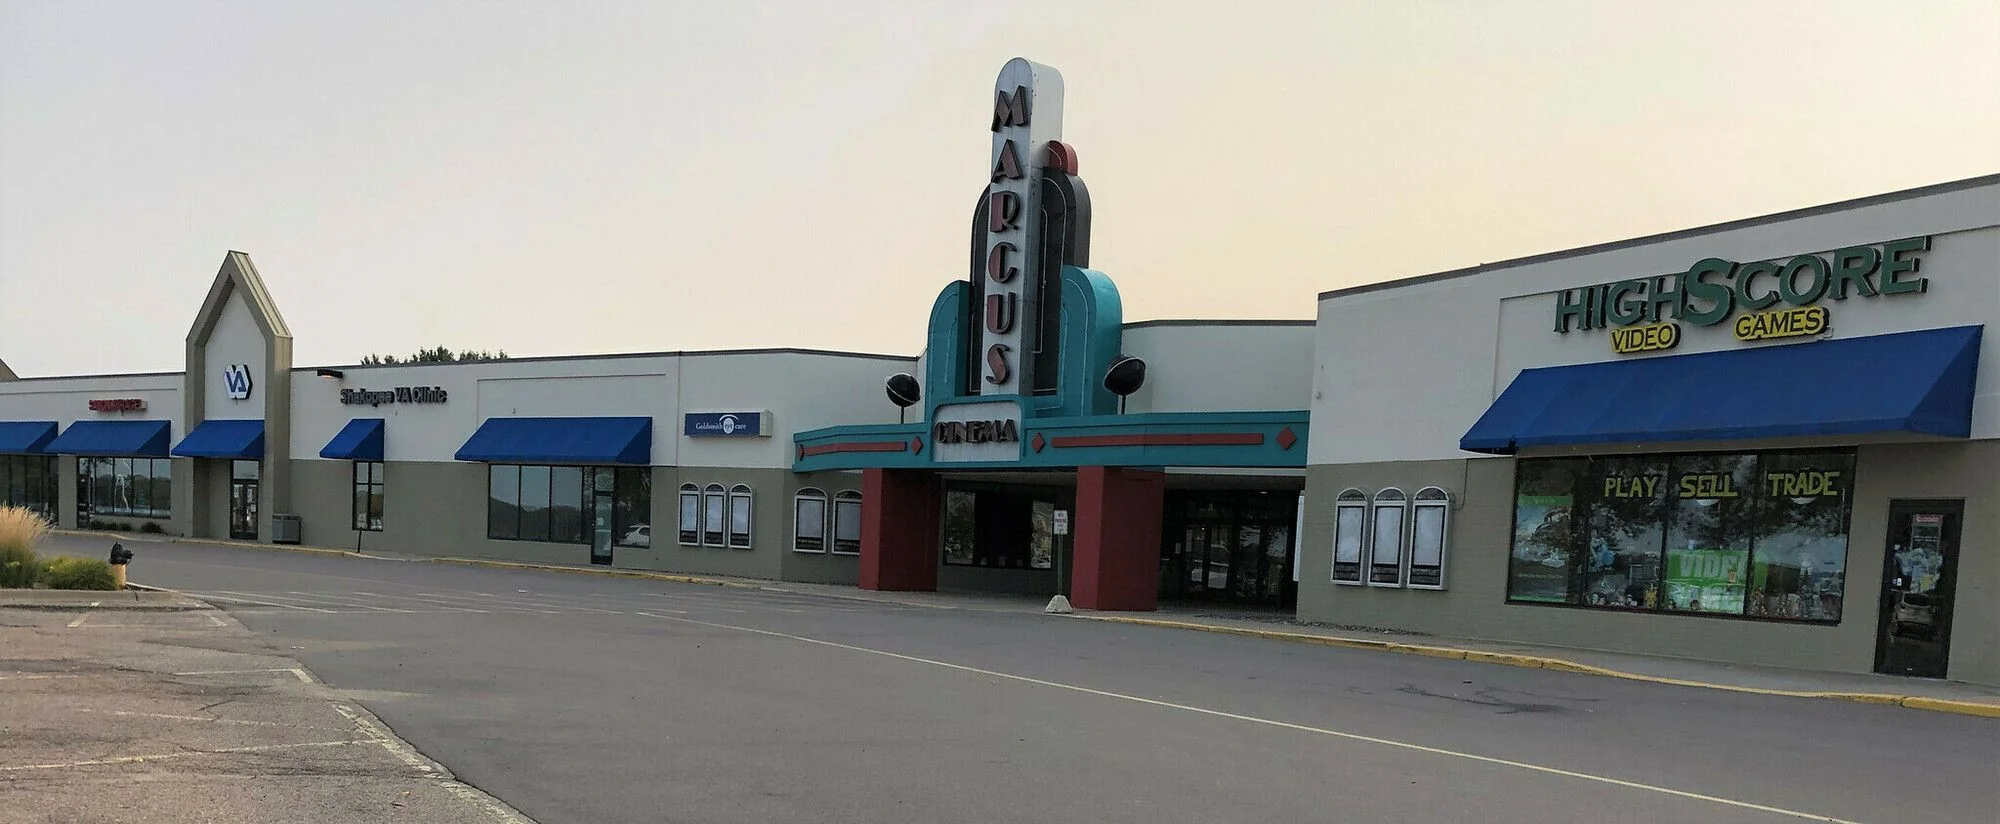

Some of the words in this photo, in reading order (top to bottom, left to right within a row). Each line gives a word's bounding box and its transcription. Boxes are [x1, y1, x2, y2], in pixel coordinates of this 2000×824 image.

[986, 84, 1029, 385] MARCUS
[1611, 323, 1677, 352] VIDEO
[1734, 307, 1825, 340] GAMES
[225, 371, 247, 392] VA
[340, 388, 395, 407] Shakopee
[395, 387, 412, 403] VA
[412, 386, 448, 403] Clinic
[934, 418, 1019, 443] CINEMA
[1604, 476, 1658, 498] PLAY
[1680, 473, 1738, 498] SELL
[1768, 471, 1841, 497] TRADE
